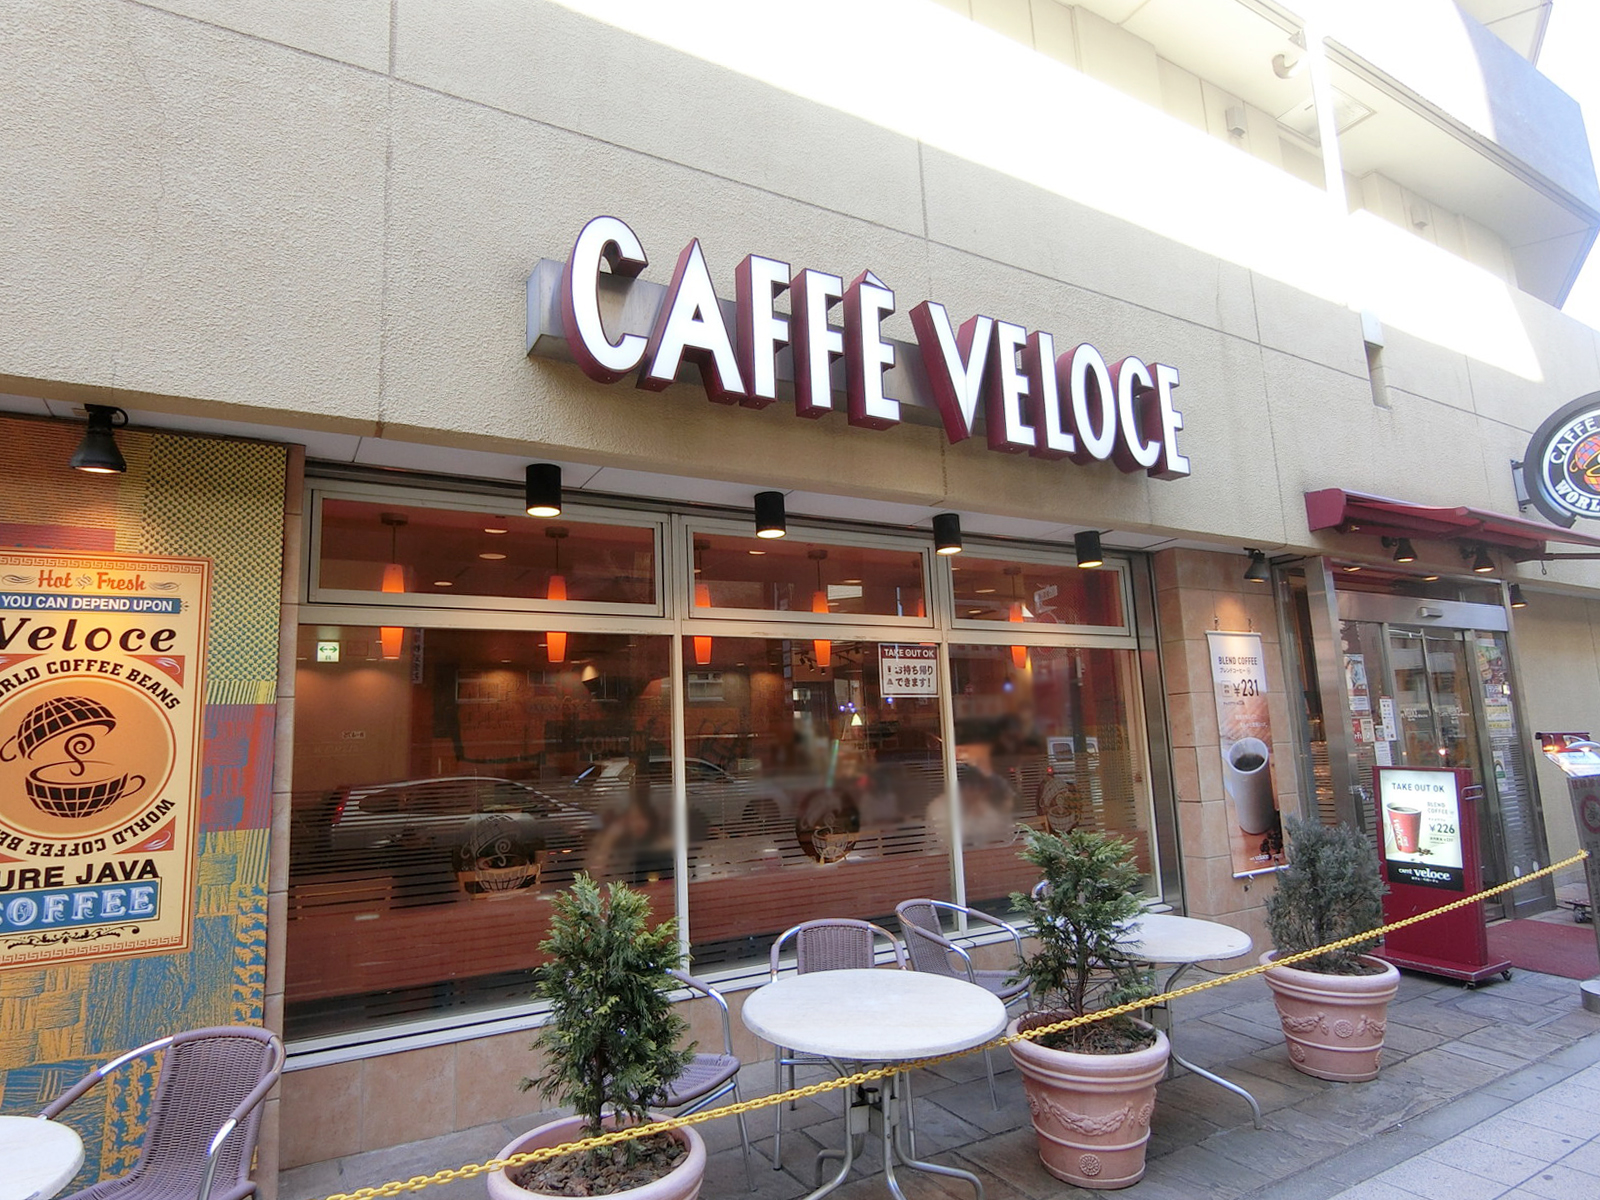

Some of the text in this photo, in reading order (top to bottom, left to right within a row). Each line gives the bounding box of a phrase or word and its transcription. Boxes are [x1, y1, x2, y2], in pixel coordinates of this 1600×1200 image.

[909, 299, 1191, 481] VELOCE
[38, 569, 72, 589] Hot
[96, 571, 147, 592] Fresh
[1, 594, 173, 612] YOU CAN DEPEND UPON
[0, 617, 177, 653] Veloce
[884, 648, 935, 658] TAKE OUT OK
[1218, 656, 1258, 665] BLEND COFFEE
[0, 658, 181, 710] RLD COFFEE BEANS
[1391, 782, 1446, 793] TAKE OUT OK
[112, 798, 176, 845] WORLD
[26, 837, 107, 857] COFFEE
[76, 858, 160, 885] JAVA
[1413, 868, 1451, 881] veloce
[0, 886, 155, 926] OFFEE
